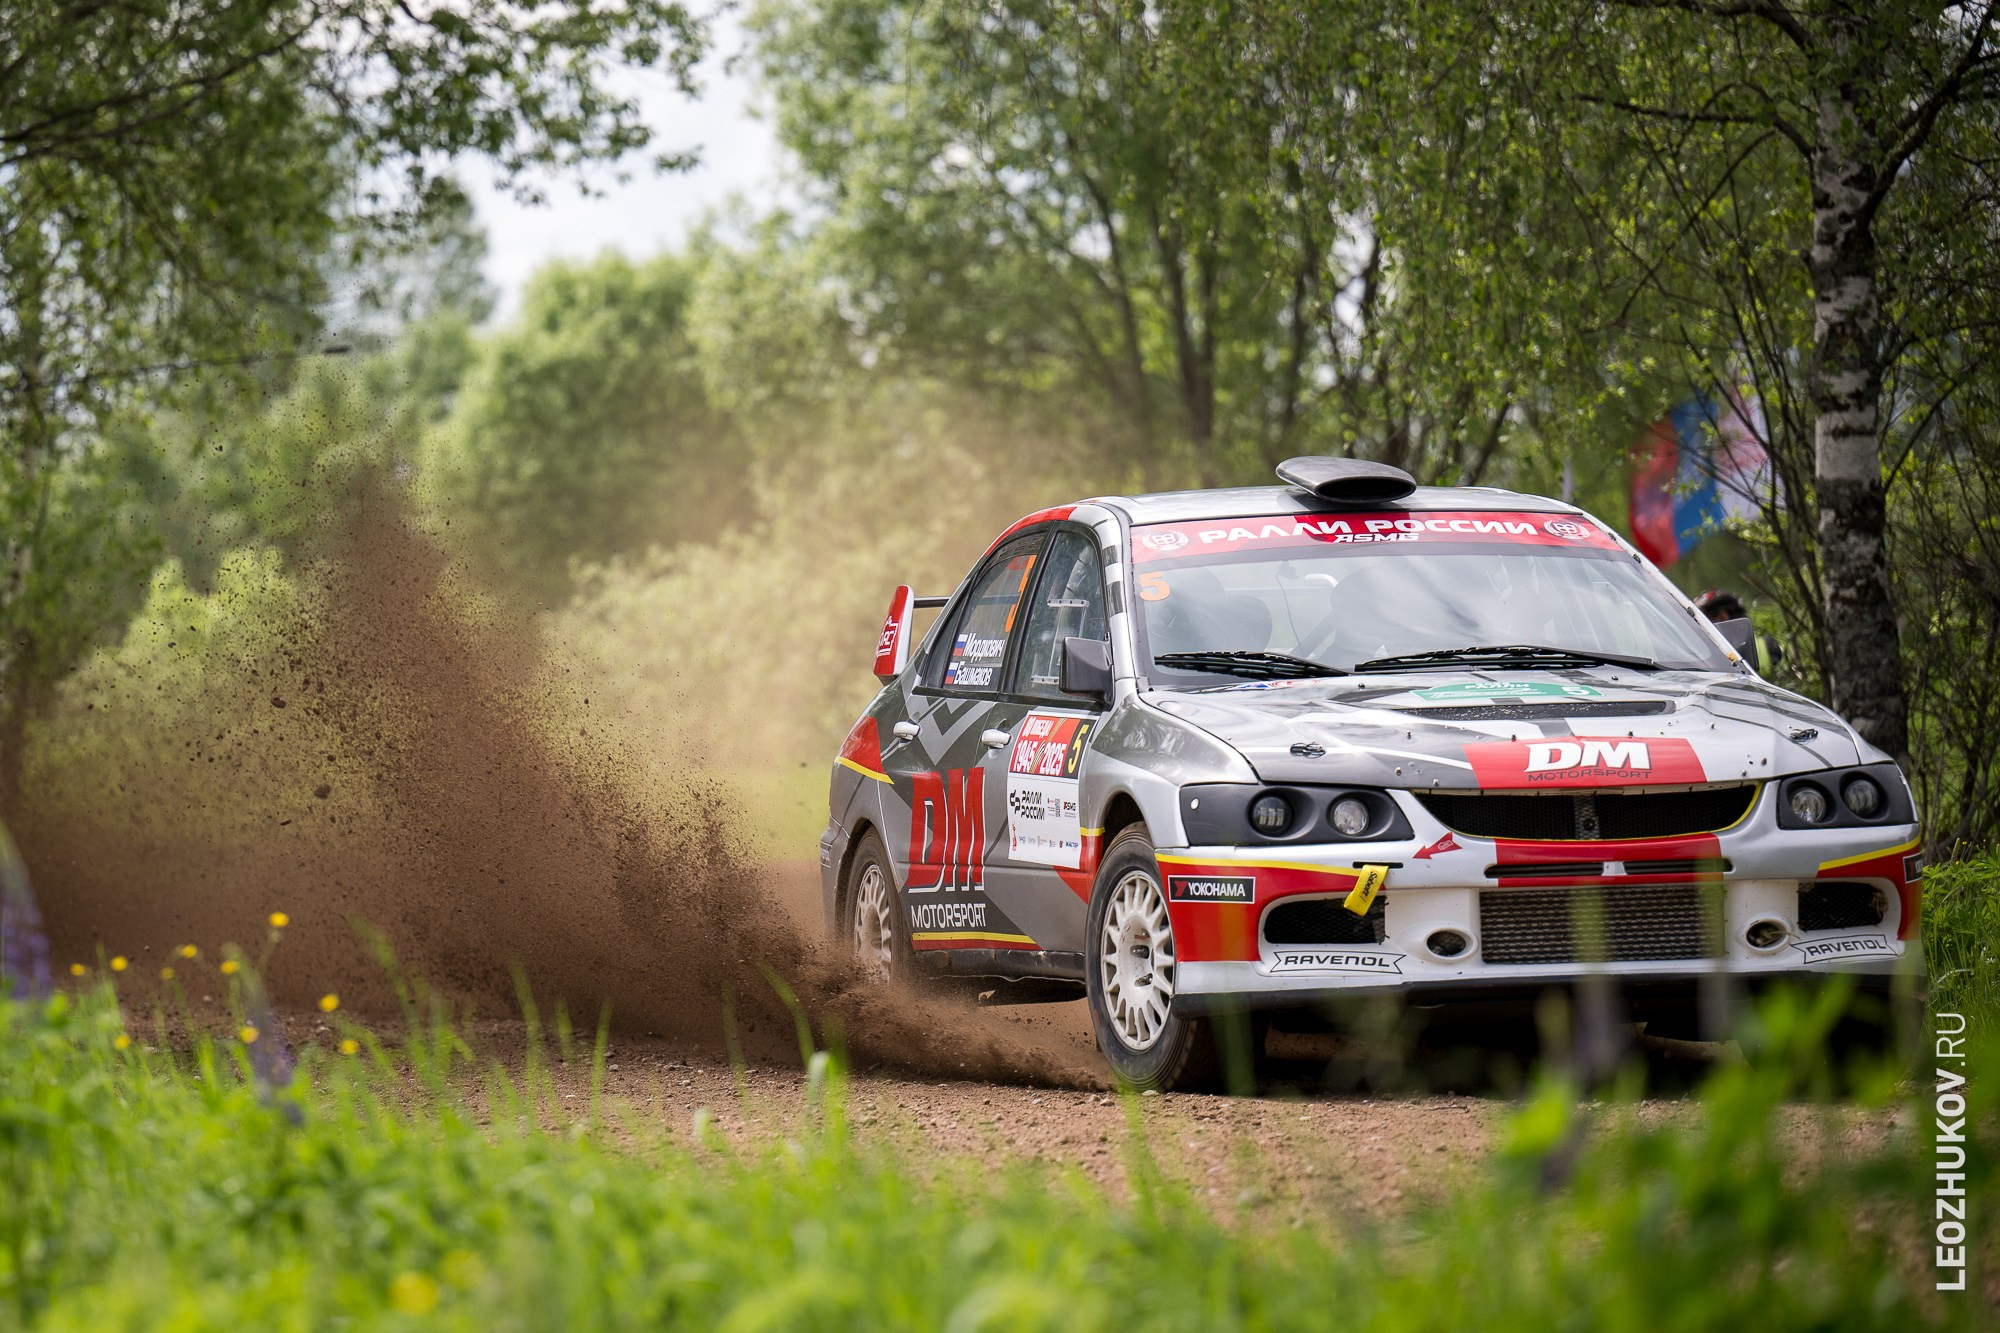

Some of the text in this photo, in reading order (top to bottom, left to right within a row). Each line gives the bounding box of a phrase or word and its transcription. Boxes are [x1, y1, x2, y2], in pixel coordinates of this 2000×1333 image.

[1198, 520, 1352, 544] РАЛЛИ
[1363, 518, 1539, 536] РОССИИ
[1138, 571, 1171, 602] 5
[962, 633, 1006, 663] Мордкович
[953, 660, 993, 686] Башмаков
[1561, 686, 1591, 696] 5
[1067, 724, 1090, 774] 5
[1523, 740, 1653, 773] DM
[1527, 769, 1653, 782] MOTORSPORT
[1021, 790, 1042, 805] РАЛЛИ
[1020, 805, 1045, 820] РОССИИ
[905, 767, 986, 894] DM
[1188, 882, 1246, 897] YOKOHAMA
[910, 903, 986, 929] MOTORSPORT
[1806, 939, 1887, 956] RAVENOL
[1284, 954, 1391, 968] RAVENOL
